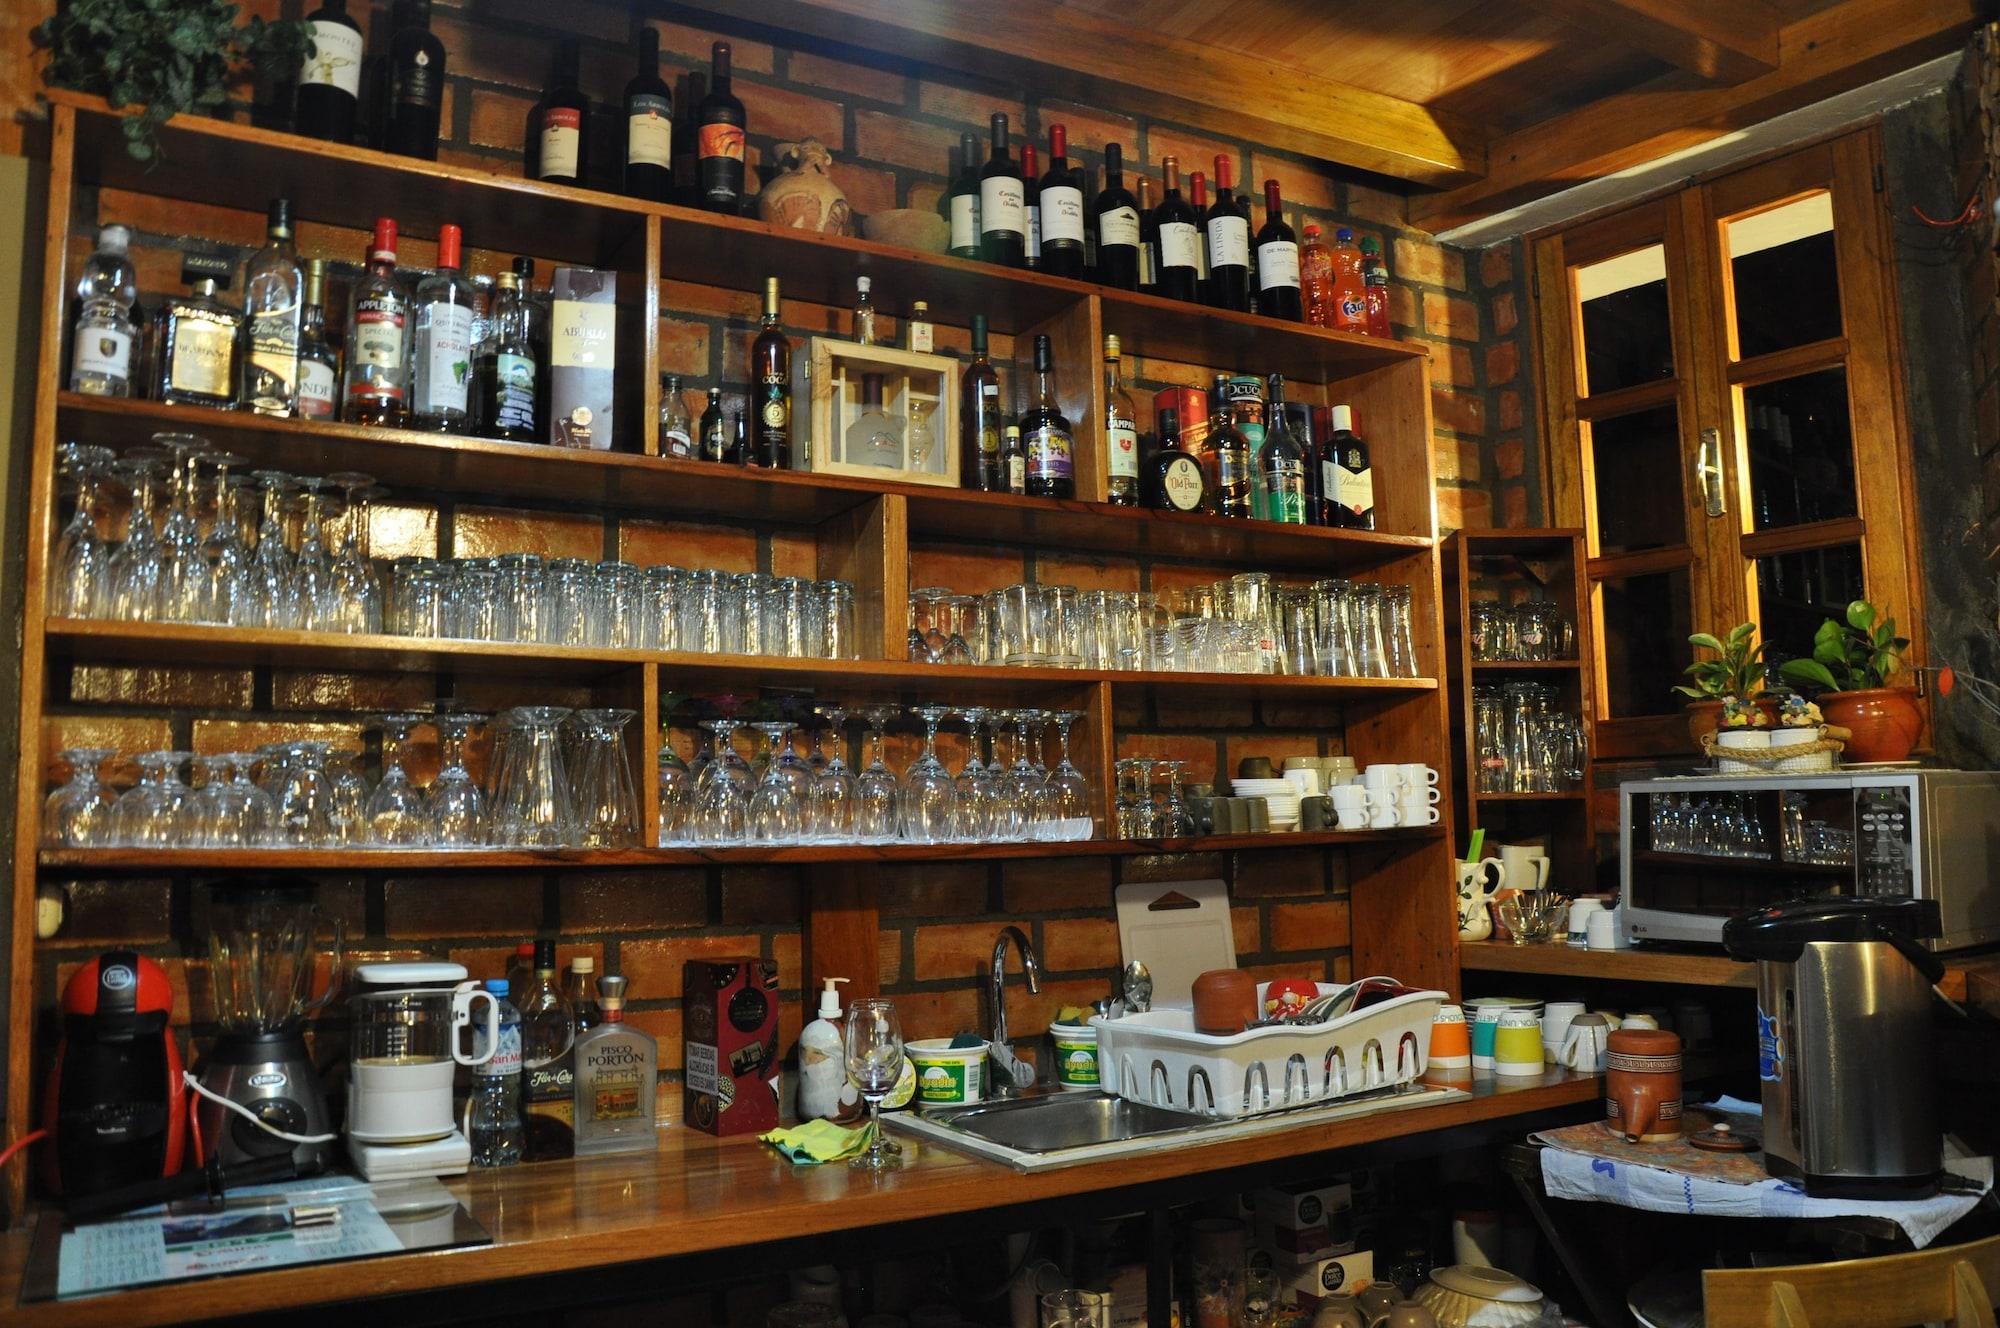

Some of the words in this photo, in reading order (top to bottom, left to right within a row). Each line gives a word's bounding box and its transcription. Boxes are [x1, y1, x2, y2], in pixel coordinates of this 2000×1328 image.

[358, 299, 404, 314] APPLETON
[1171, 476, 1183, 490] Old
[600, 1045, 633, 1055] PISCO
[530, 1071, 551, 1088] Flor
